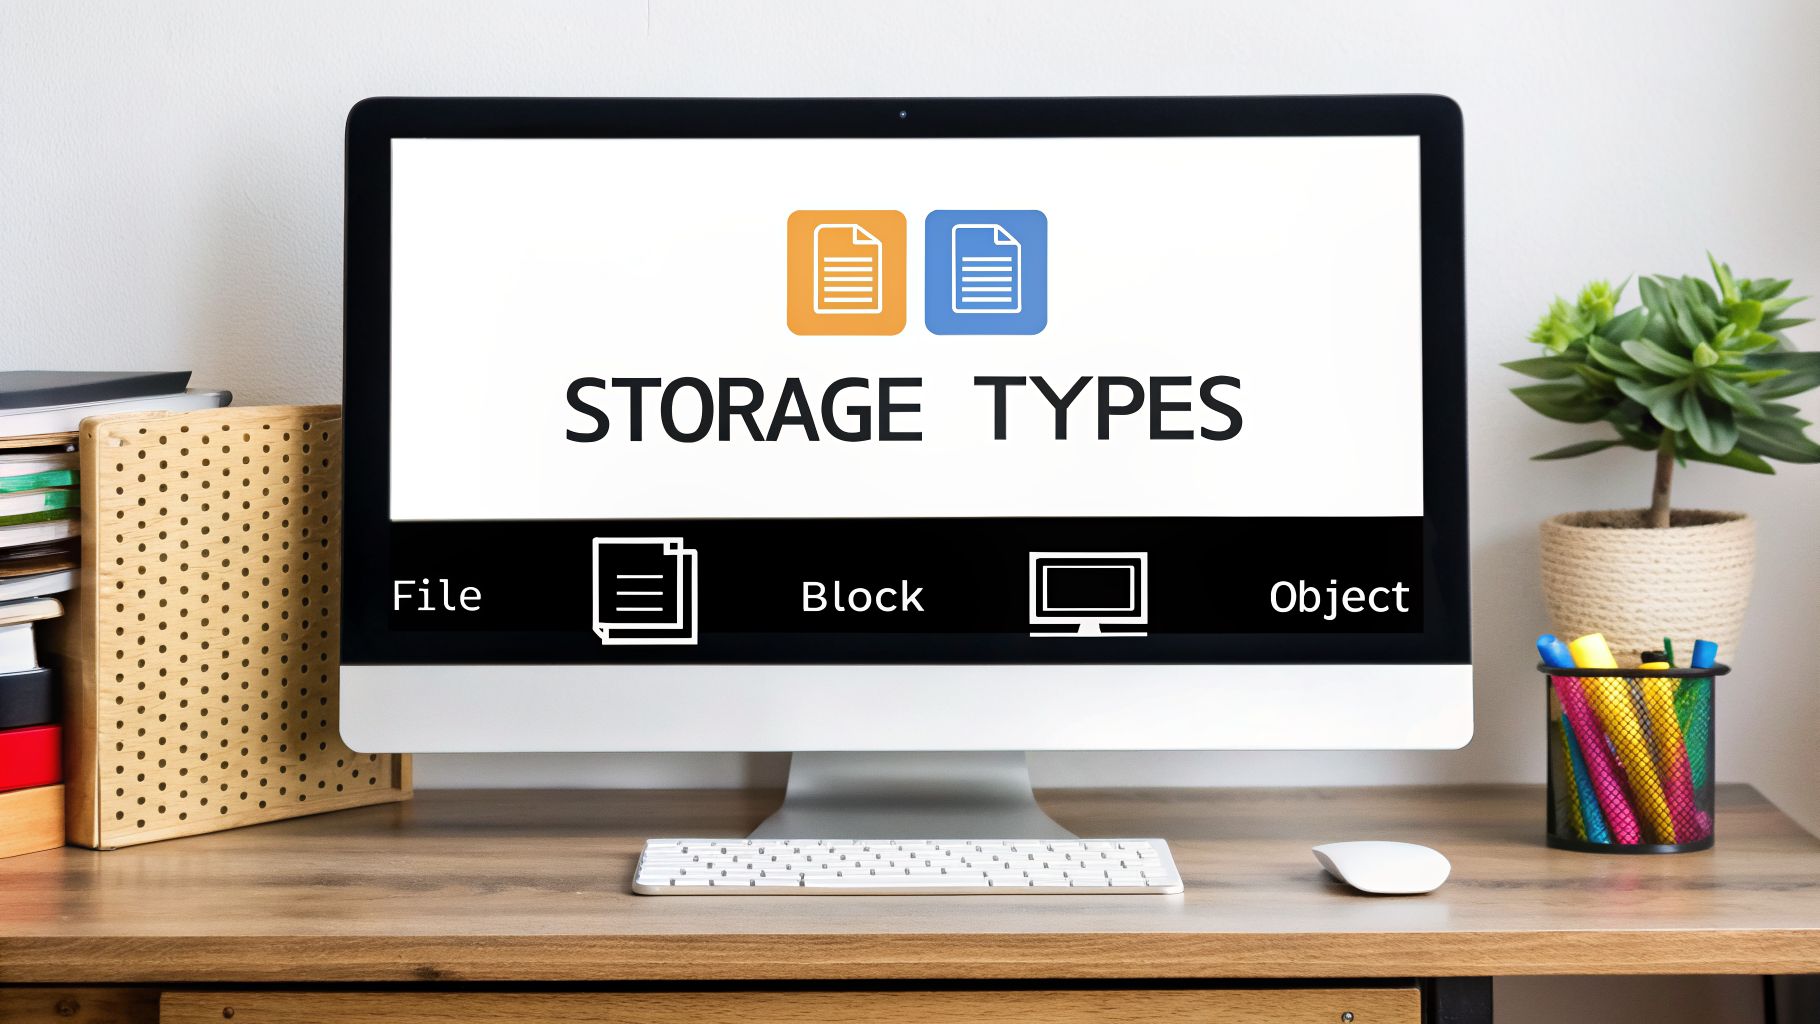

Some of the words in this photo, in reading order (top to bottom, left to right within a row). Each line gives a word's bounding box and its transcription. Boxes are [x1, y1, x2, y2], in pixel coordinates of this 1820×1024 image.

[565, 376, 924, 444] STORAGE
[973, 374, 1244, 443] TYPES
[392, 577, 483, 612] File
[801, 579, 926, 613] Block
[1269, 579, 1411, 621] Object
